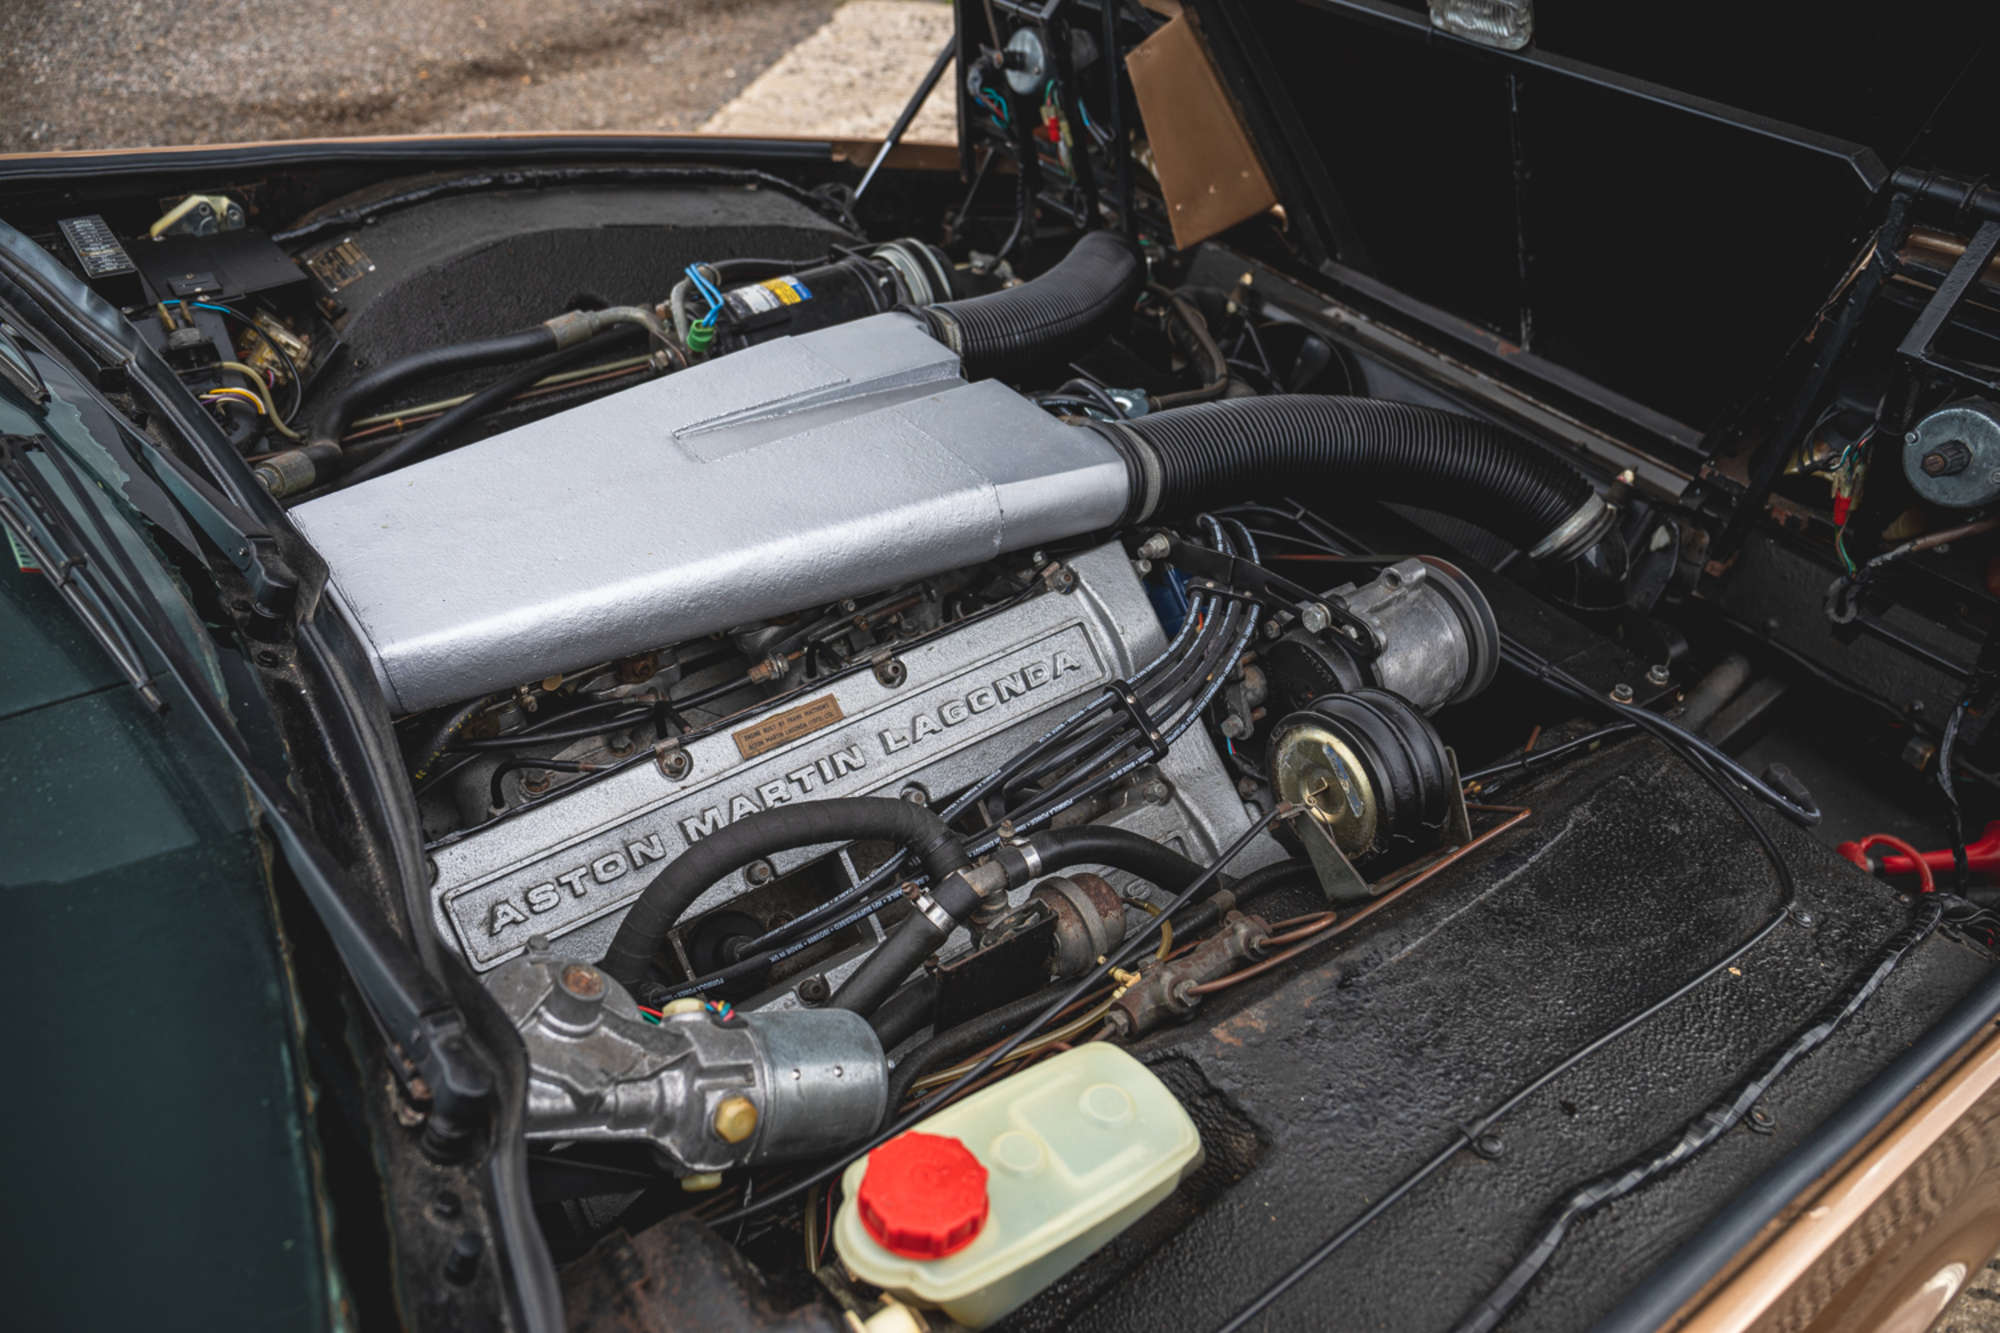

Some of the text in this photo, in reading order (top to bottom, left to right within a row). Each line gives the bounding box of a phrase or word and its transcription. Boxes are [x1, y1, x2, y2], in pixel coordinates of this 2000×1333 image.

[488, 833, 667, 937] ASTON
[677, 744, 867, 844] MARTIN
[878, 650, 1080, 755] LAGONDA
